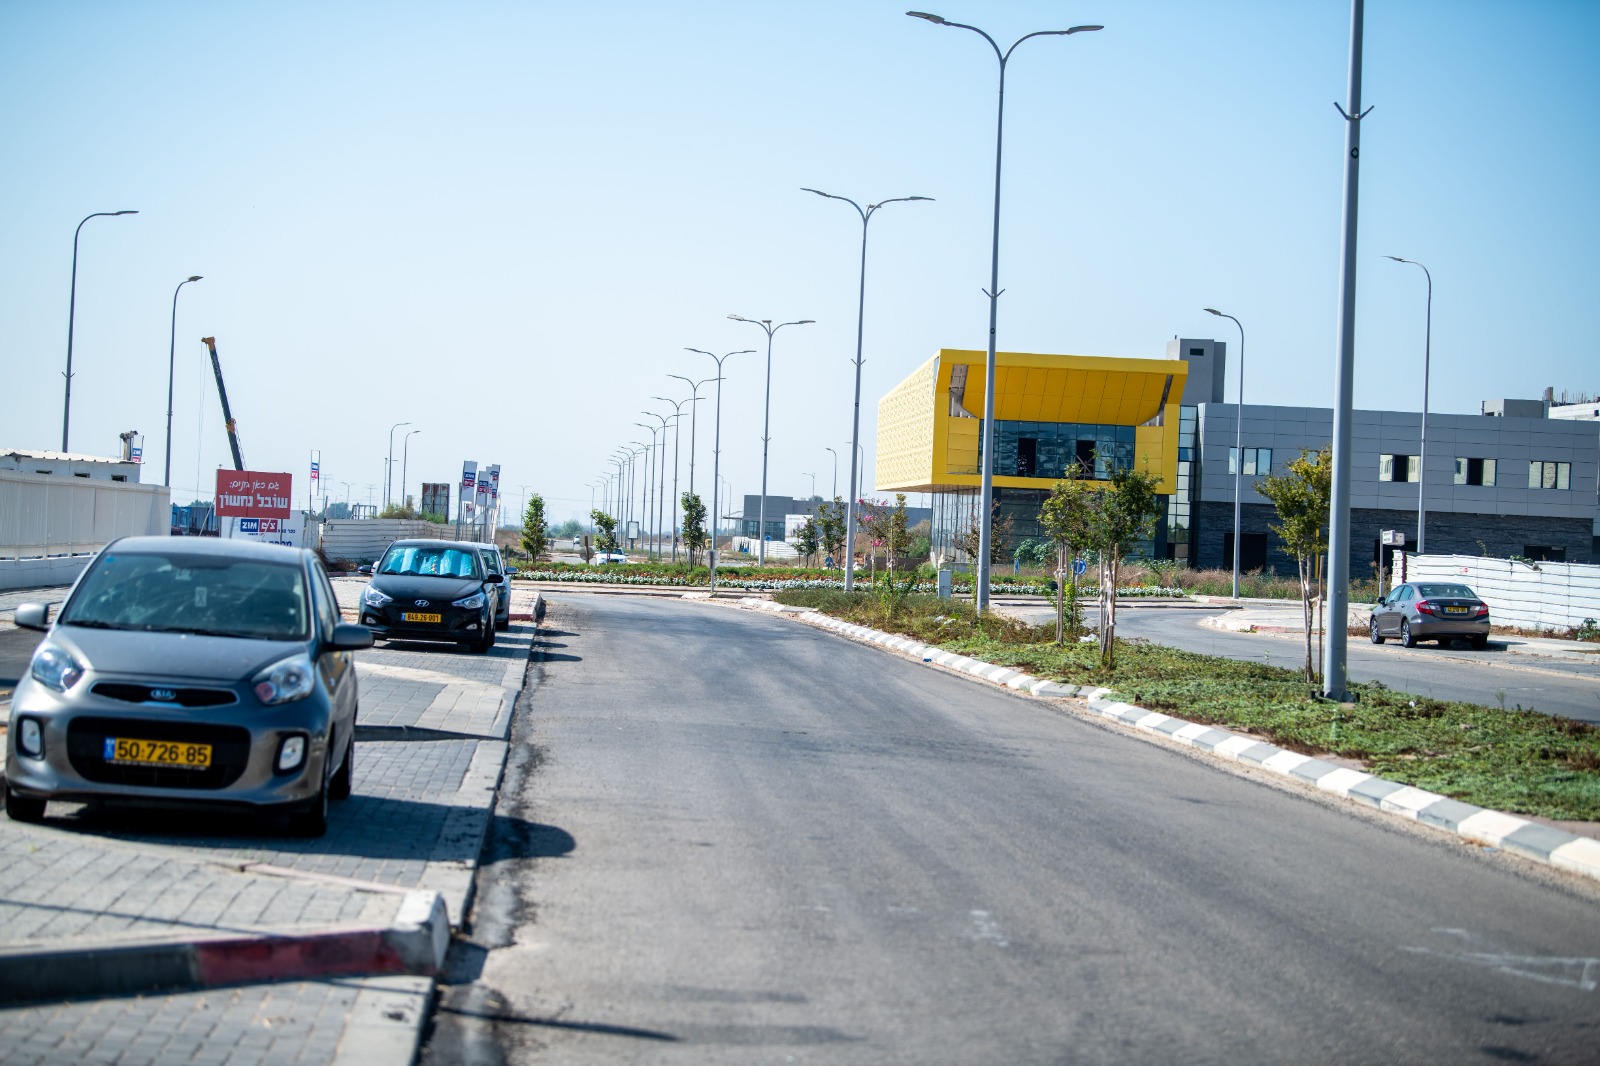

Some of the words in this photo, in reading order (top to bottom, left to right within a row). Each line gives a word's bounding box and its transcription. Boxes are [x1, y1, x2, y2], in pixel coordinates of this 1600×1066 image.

[251, 480, 265, 493] כאן
[268, 481, 280, 490] גם
[219, 491, 254, 508] נחשון
[257, 493, 288, 508] שובל
[242, 521, 257, 530] ZIM
[155, 689, 172, 698] KIA
